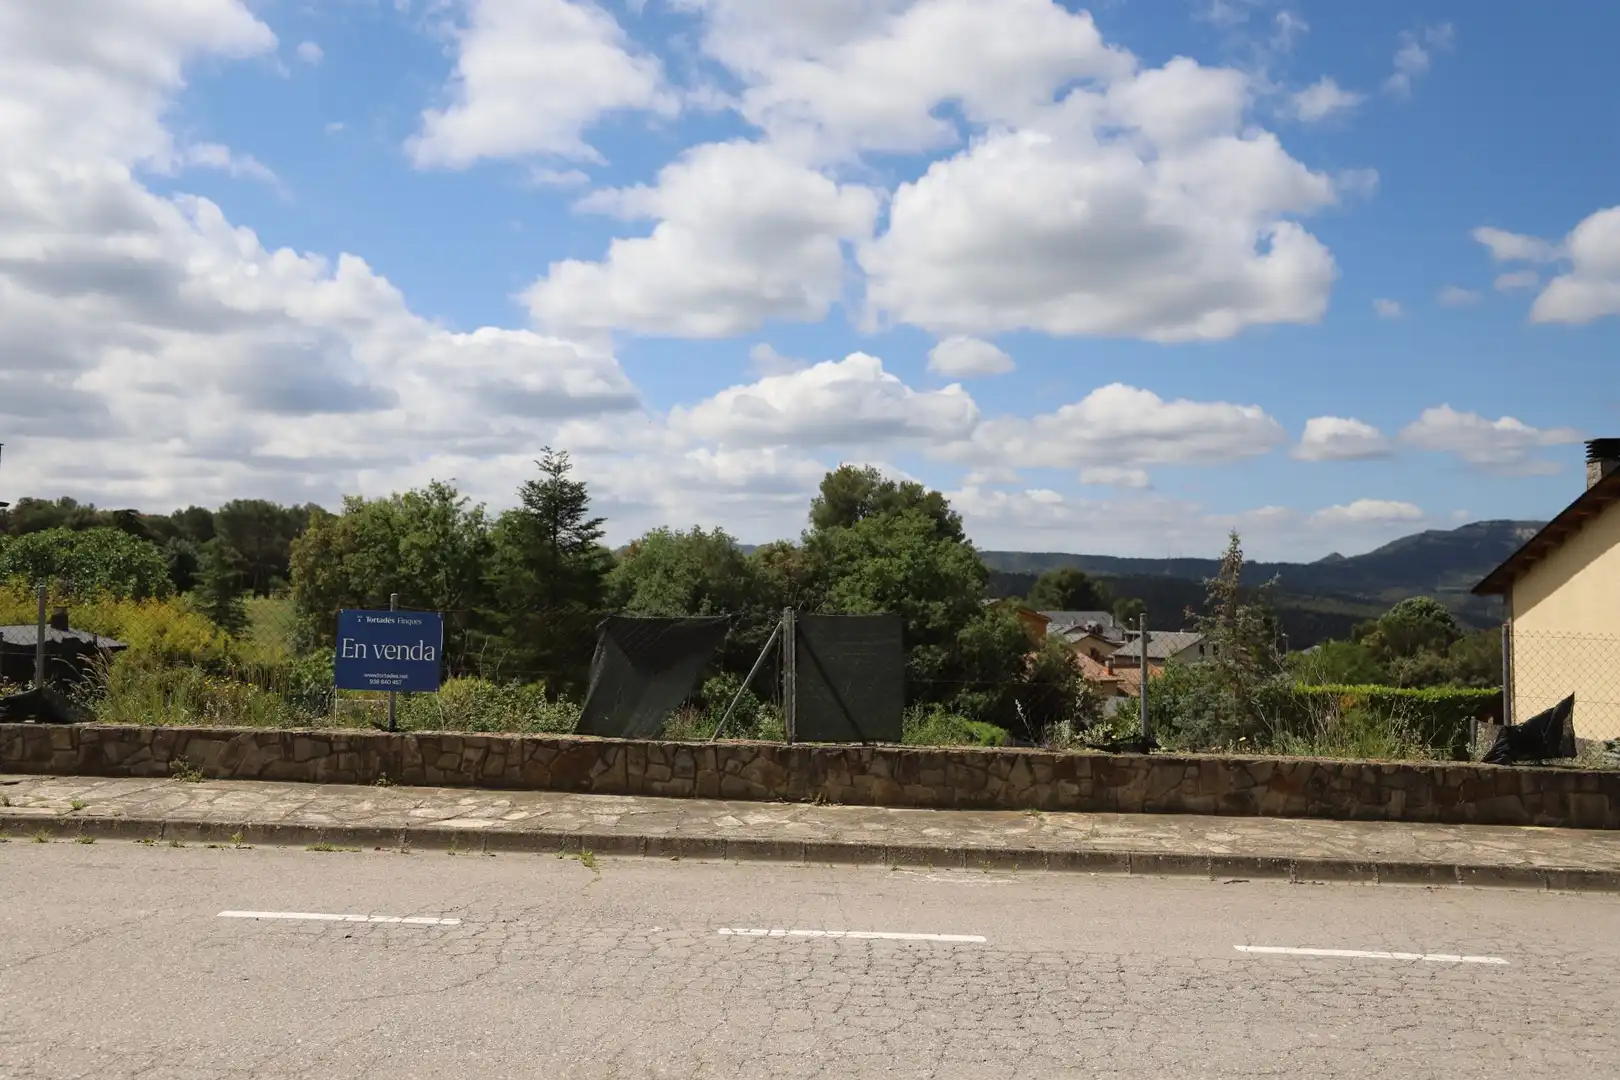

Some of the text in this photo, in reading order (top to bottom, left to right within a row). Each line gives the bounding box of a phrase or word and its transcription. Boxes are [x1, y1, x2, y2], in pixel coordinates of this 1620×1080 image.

[397, 617, 422, 626] Finques
[341, 638, 435, 661] En venda
